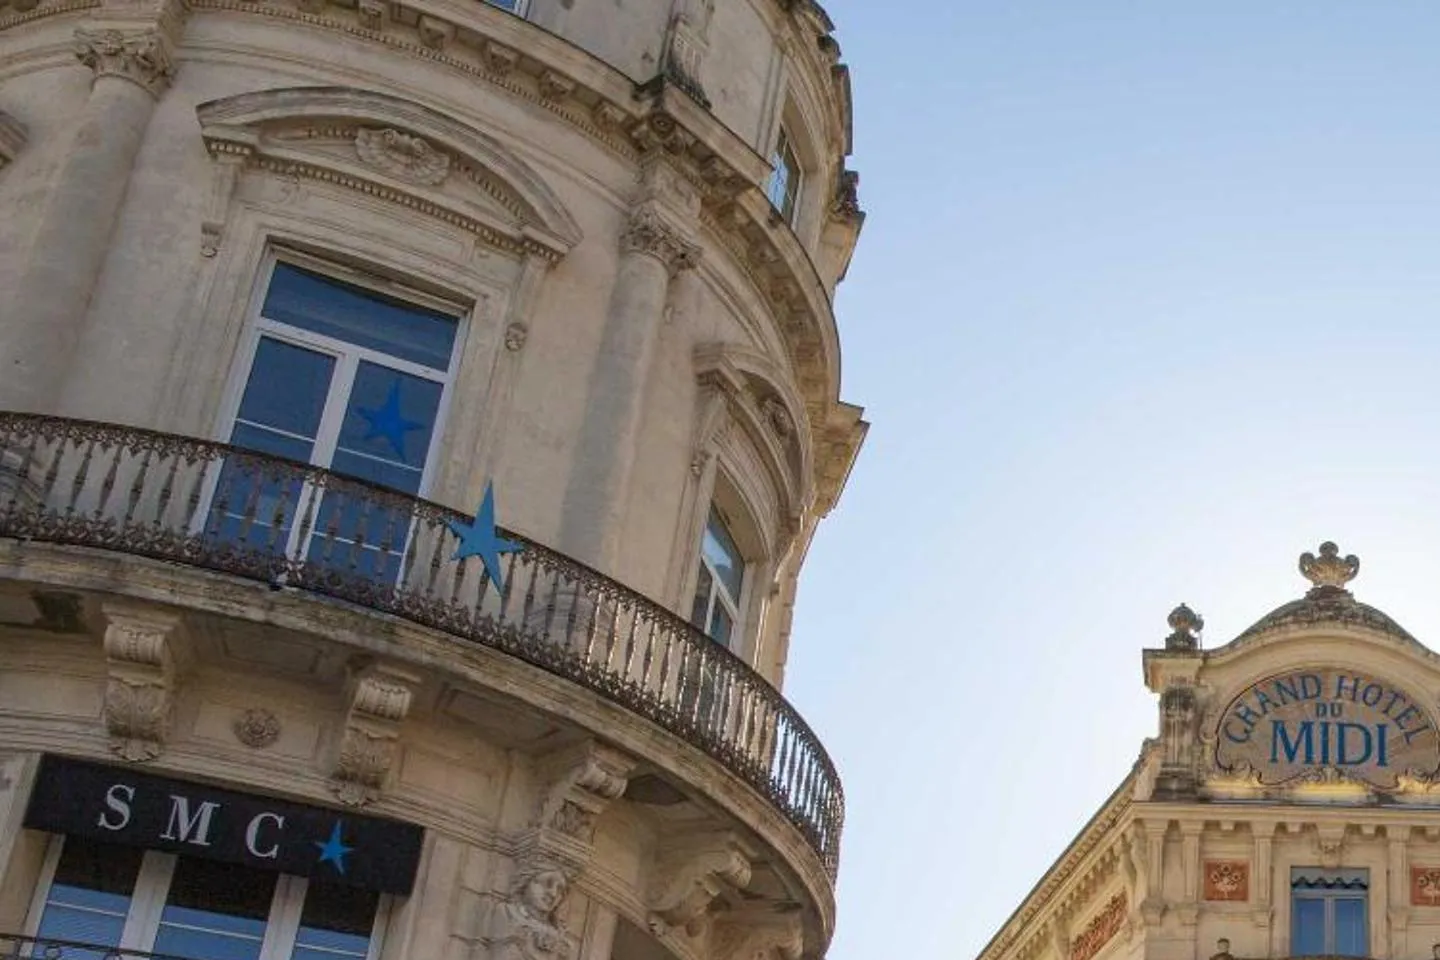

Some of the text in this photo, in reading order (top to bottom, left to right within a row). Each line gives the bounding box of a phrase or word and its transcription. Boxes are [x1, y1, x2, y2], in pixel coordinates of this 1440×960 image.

[1223, 673, 1430, 744] GRAND HOTEL
[1315, 702, 1344, 718] DU
[1269, 720, 1389, 767] MIDI
